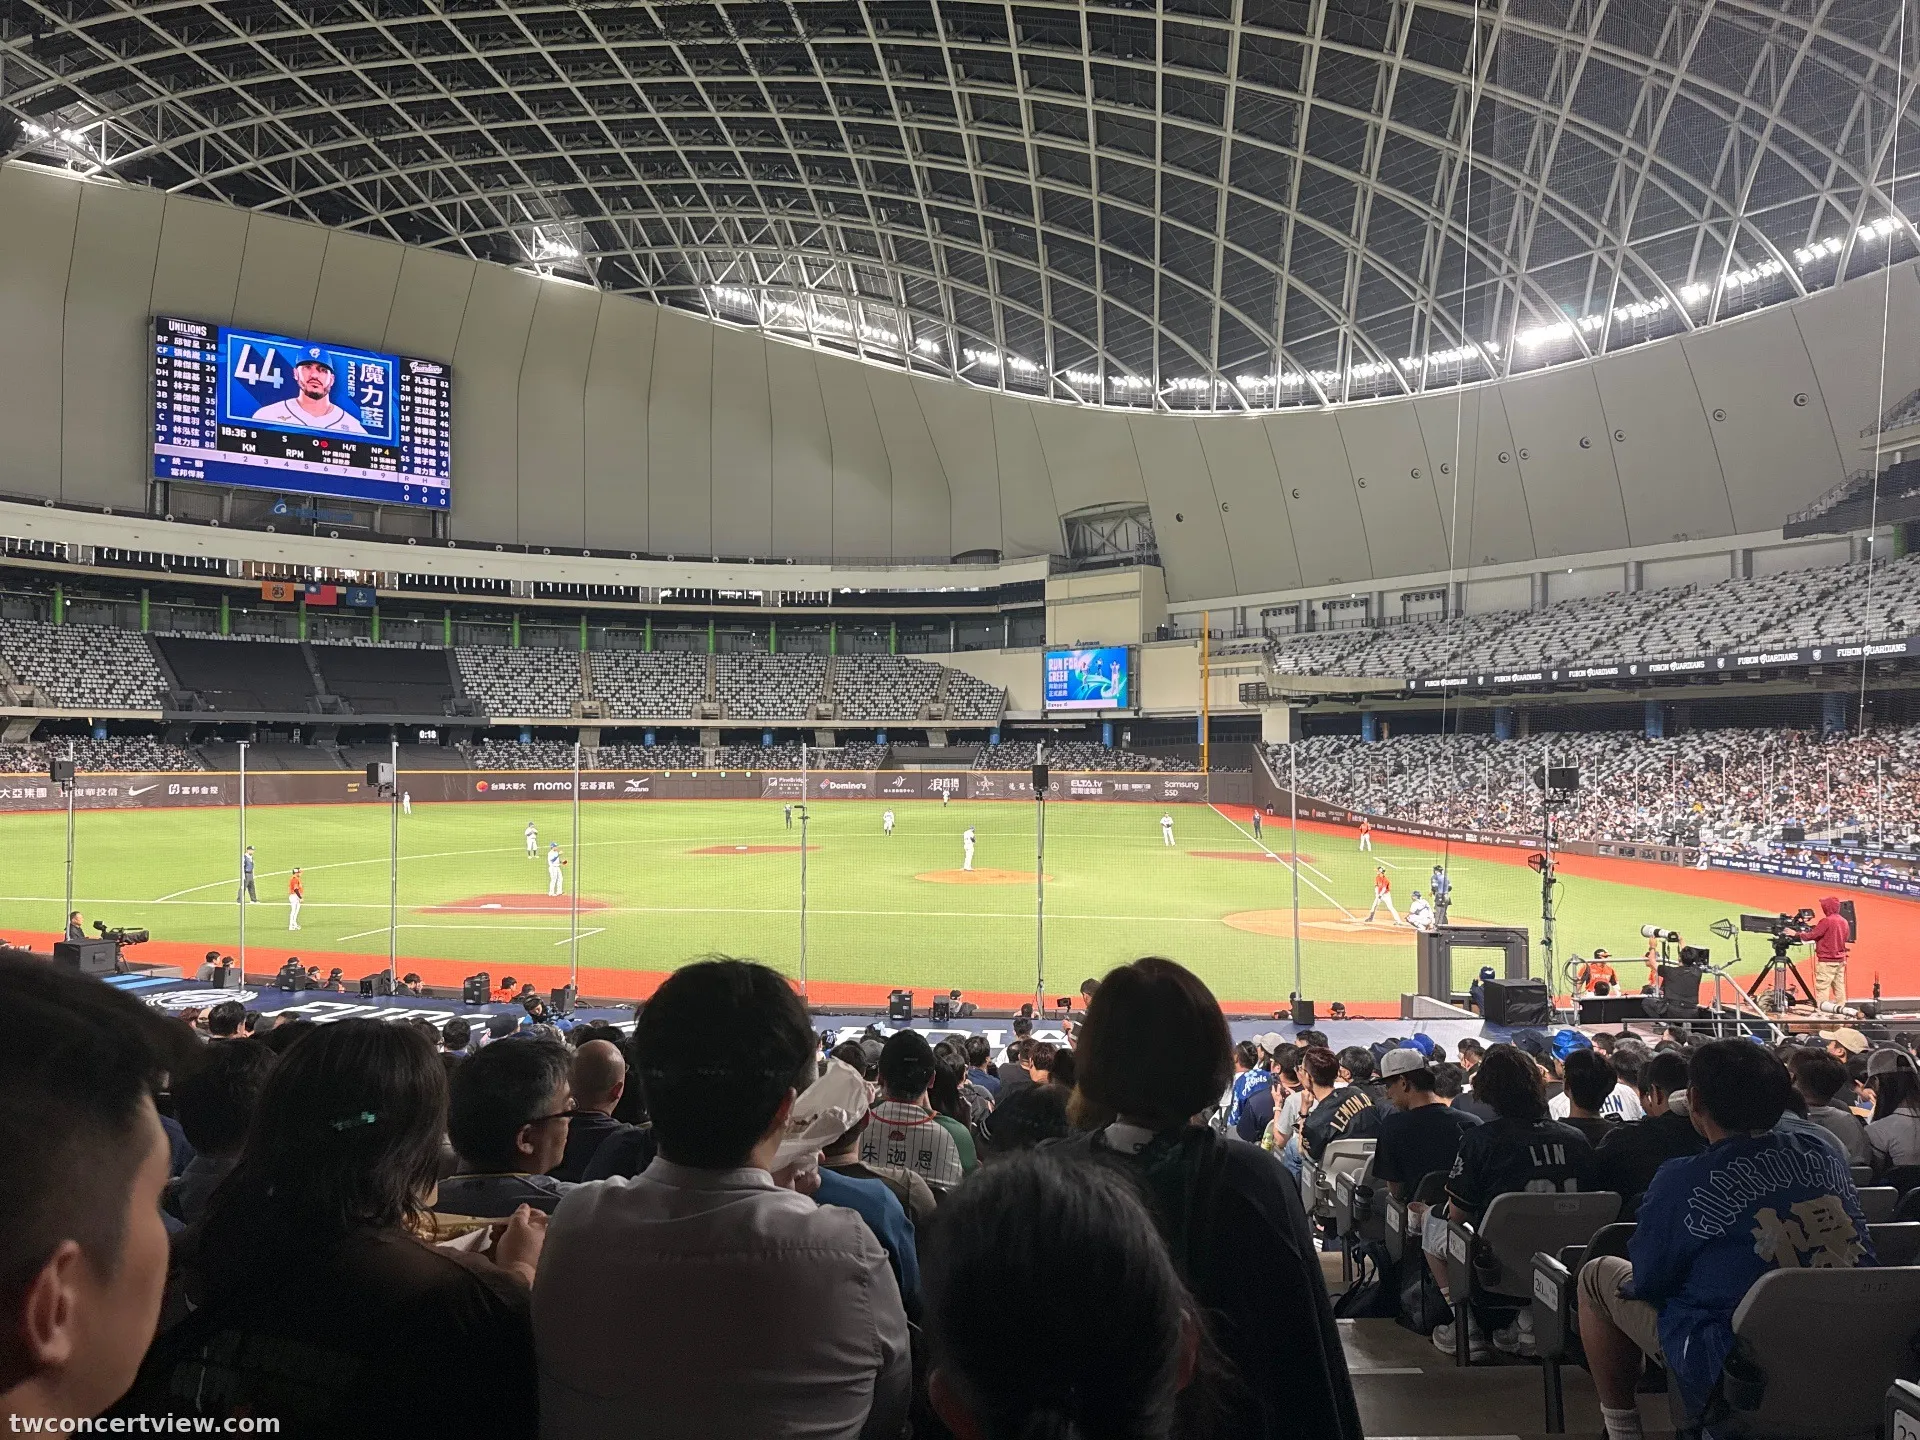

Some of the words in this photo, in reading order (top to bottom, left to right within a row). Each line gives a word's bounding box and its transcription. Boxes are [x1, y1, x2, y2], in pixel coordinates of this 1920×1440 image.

[169, 321, 207, 336] UNILIONS
[157, 334, 168, 343] RF
[157, 357, 168, 365] LF
[206, 365, 216, 373] 24
[234, 344, 284, 389] 44
[156, 368, 169, 376] DH
[348, 361, 356, 397] PITCHER
[360, 363, 384, 429] 魔力藍
[156, 424, 167, 432] 2B
[221, 426, 247, 438] 18:36
[251, 431, 257, 439] B
[282, 435, 288, 443] S
[342, 443, 357, 451] H/E
[205, 441, 215, 449] 88
[242, 443, 256, 453] KM
[286, 448, 304, 459] RPM
[1836, 647, 1862, 657] FUBON
[1863, 643, 1907, 656] GUARDIANS
[1737, 656, 1759, 666] FUBON
[1759, 652, 1799, 665] GUARDIANS
[1649, 663, 1669, 672] FUBON
[1669, 660, 1705, 672] GUARDIANS
[1494, 675, 1511, 683] FUBON
[1568, 669, 1587, 678] FUBON
[419, 729, 437, 739] 0:18
[490, 782, 527, 791] 台灣大哥大
[533, 781, 573, 791] momo
[829, 781, 867, 790] Domino's
[927, 777, 960, 792] 浪直播
[1070, 779, 1102, 788] ELTA.tv
[1164, 780, 1199, 791] Samsung
[0, 787, 47, 799] 大亞集團
[74, 787, 119, 797] 復華投信
[1164, 789, 1178, 797] SSD
[861, 1142, 933, 1171] 朱迦恩
[1529, 1143, 1566, 1167] LIN
